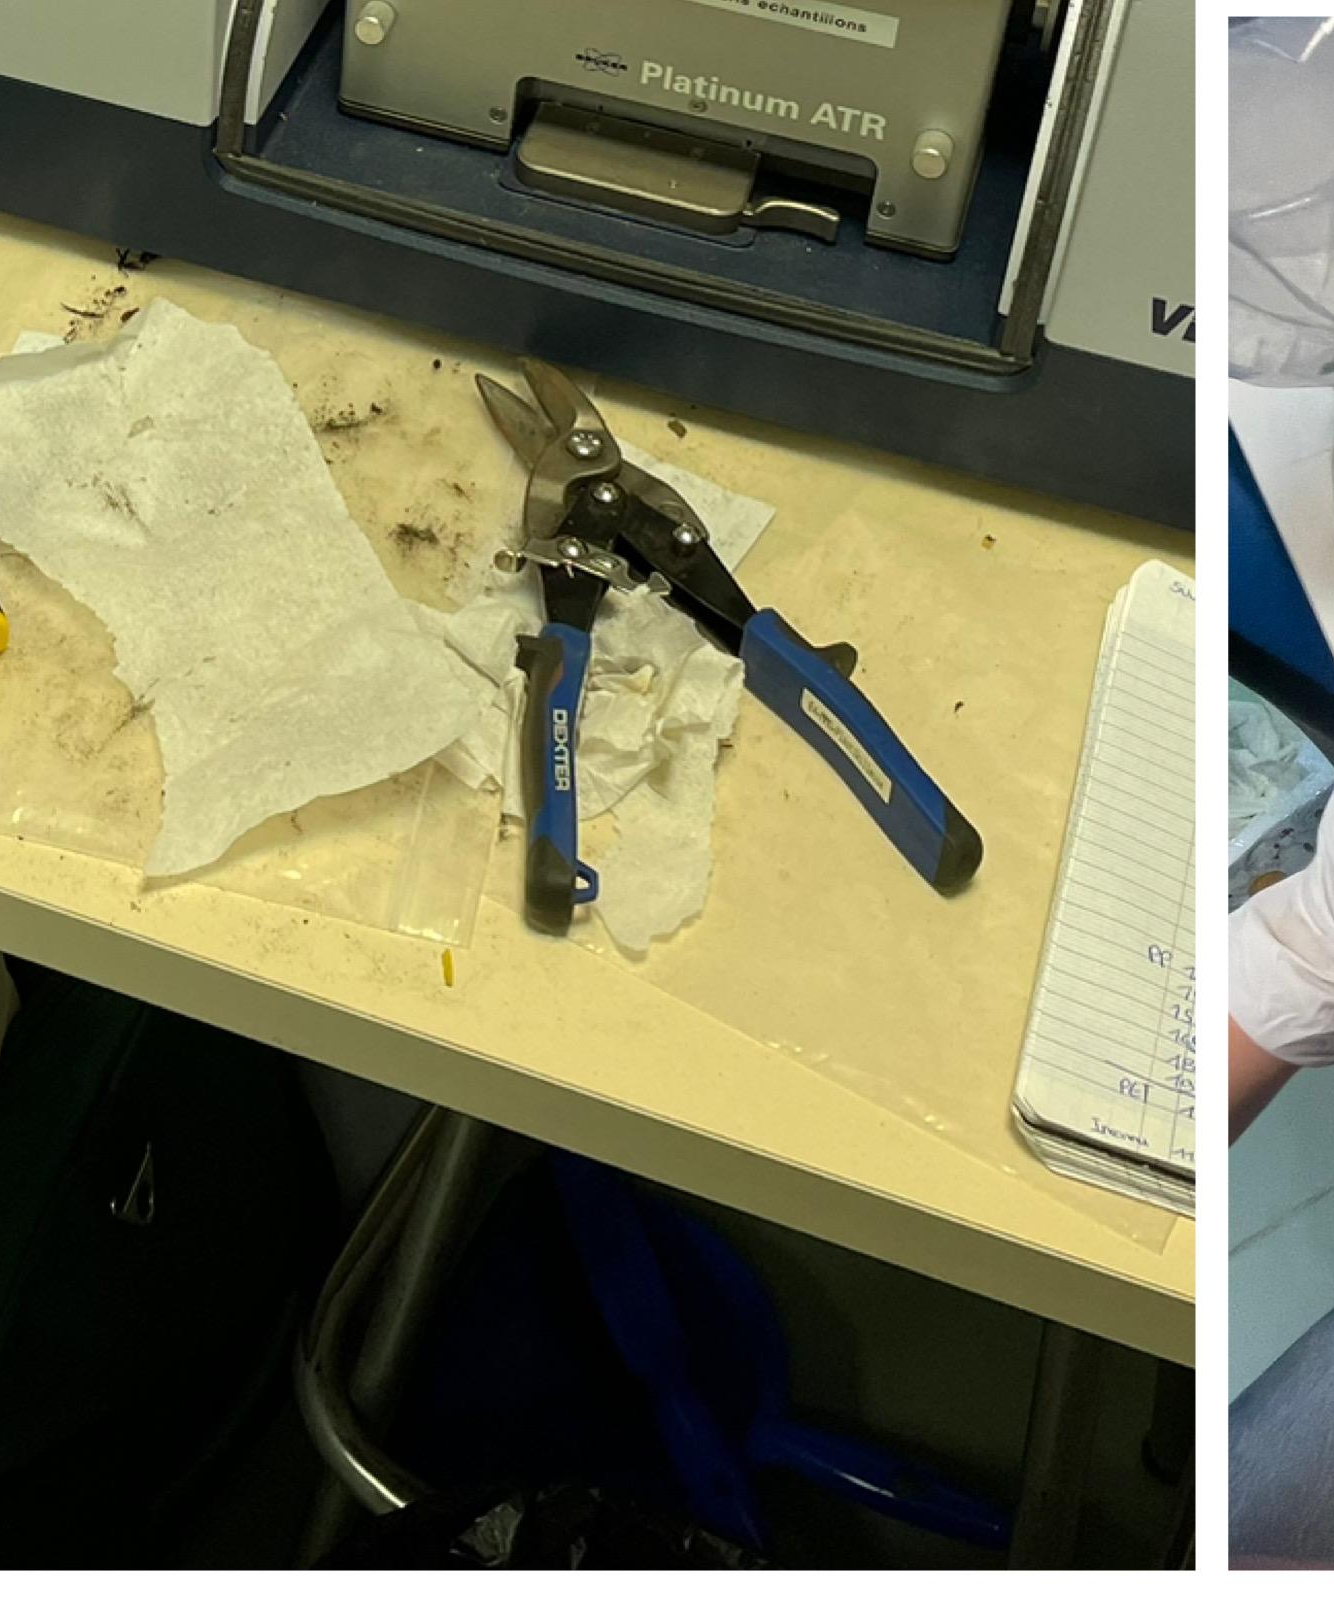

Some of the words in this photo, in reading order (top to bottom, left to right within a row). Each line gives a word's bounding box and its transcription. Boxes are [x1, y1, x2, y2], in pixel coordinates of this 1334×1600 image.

[640, 60, 800, 120] Platinum
[810, 102, 887, 140] ATR
[552, 708, 571, 792] DEXTER
